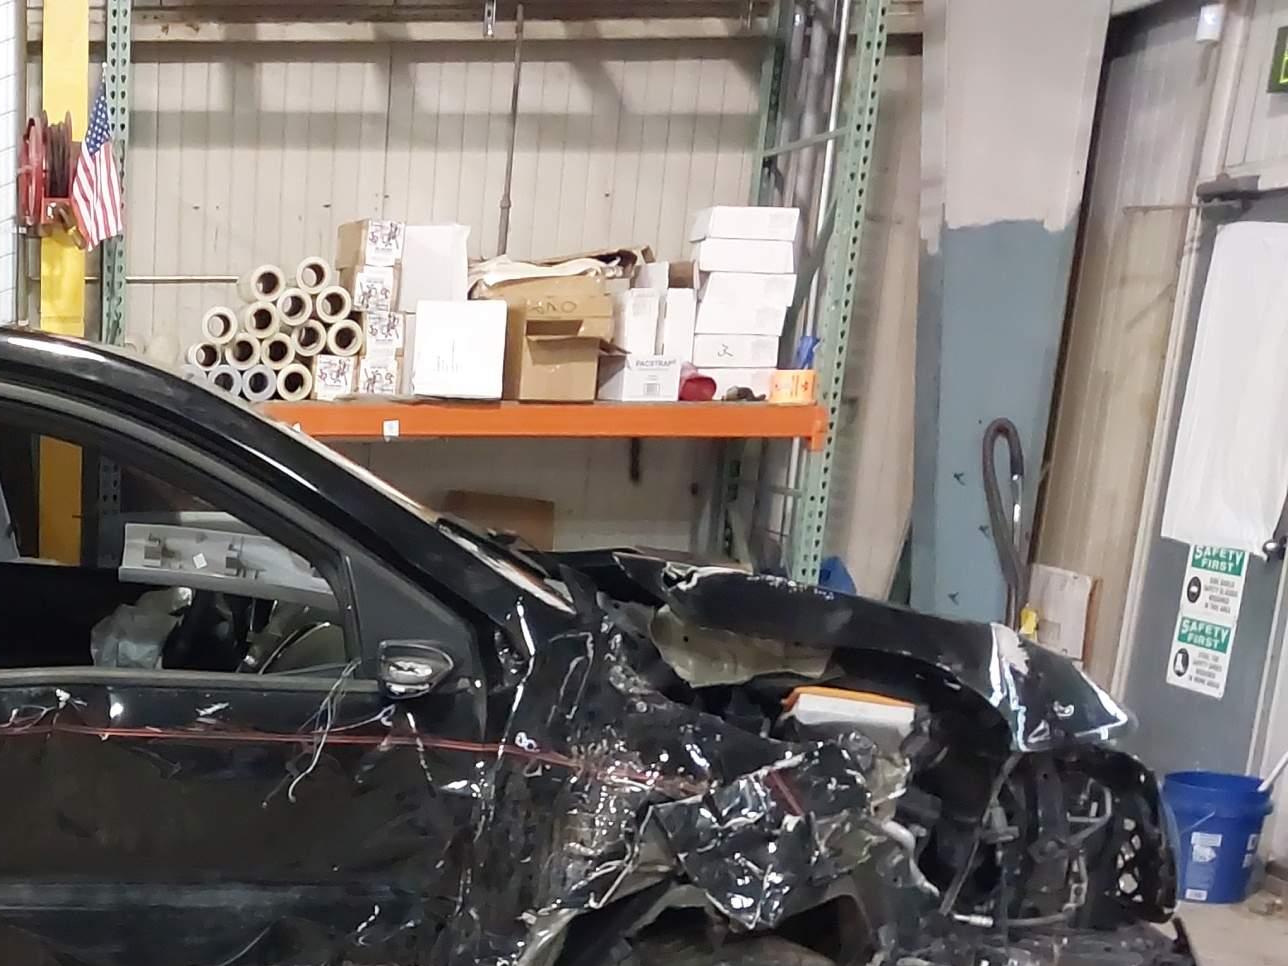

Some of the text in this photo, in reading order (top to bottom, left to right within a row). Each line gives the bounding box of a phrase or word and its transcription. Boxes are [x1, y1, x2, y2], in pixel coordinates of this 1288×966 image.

[1194, 545, 1244, 566] SAFETY
[1200, 558, 1234, 573] FIRST
[1181, 617, 1231, 643] SAFETY
[1186, 633, 1220, 650] FIRST
